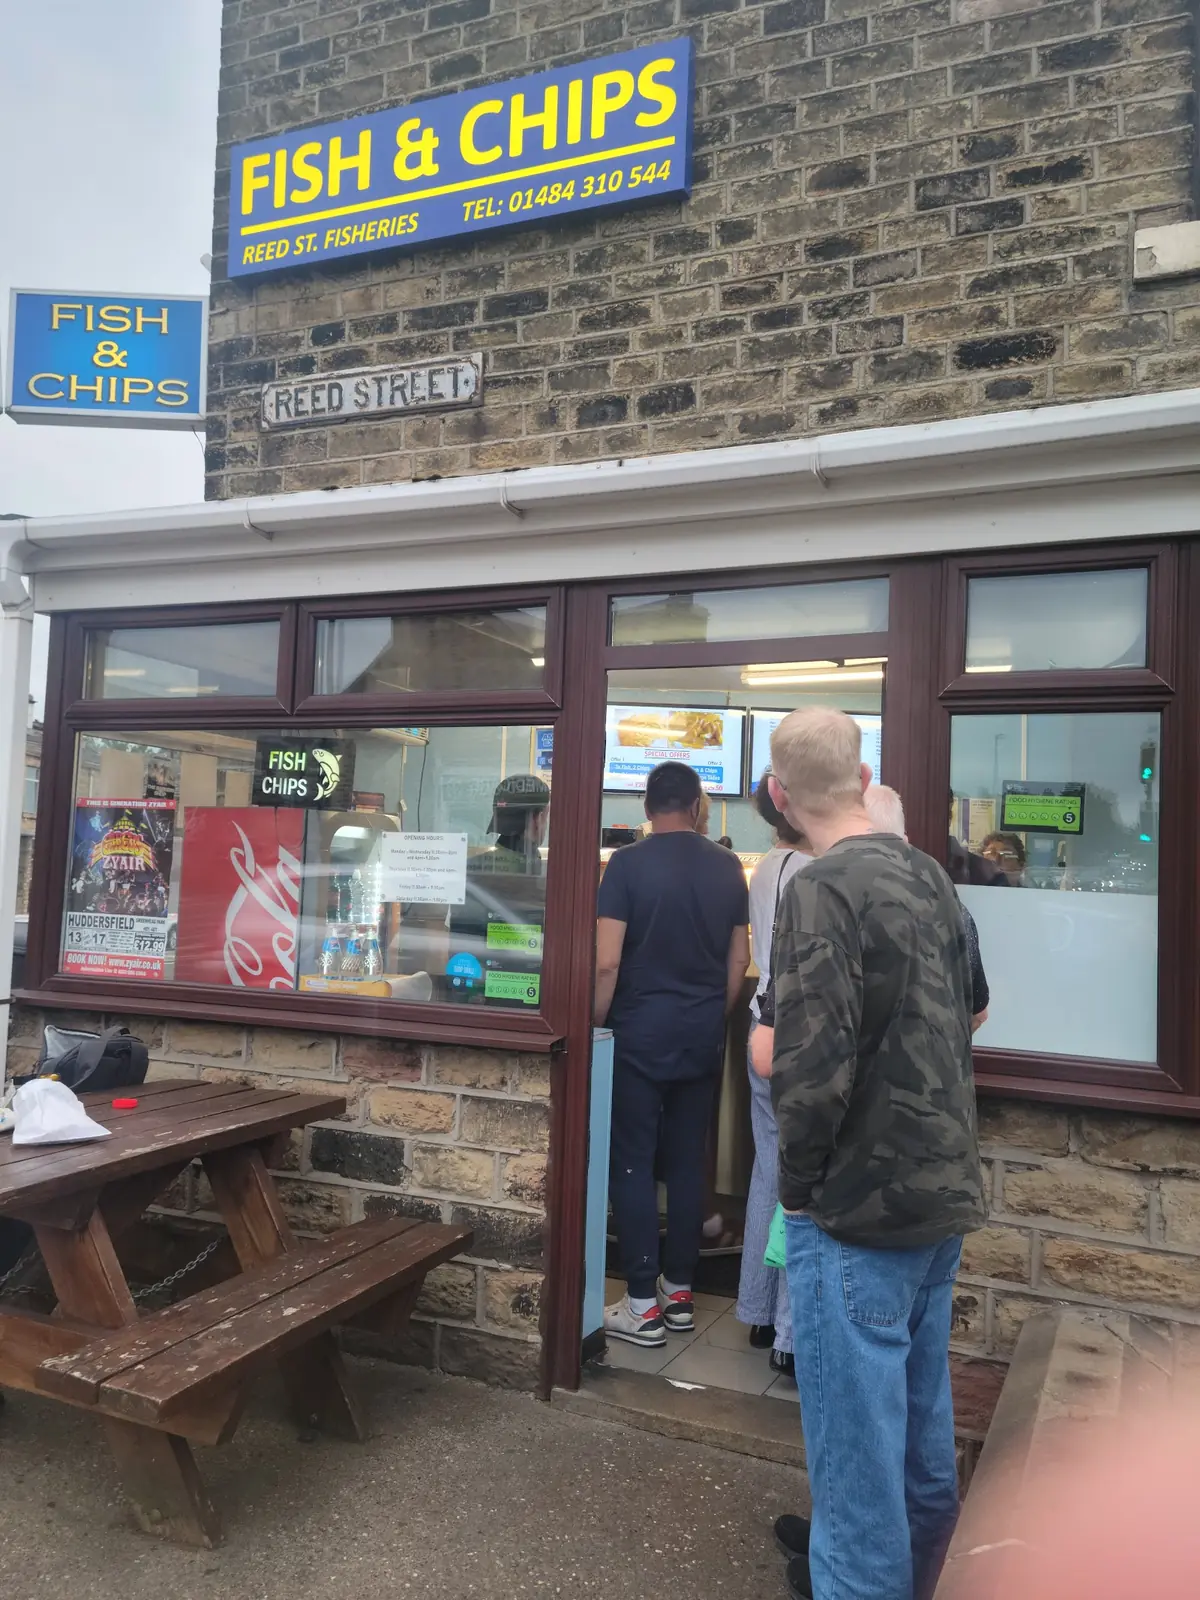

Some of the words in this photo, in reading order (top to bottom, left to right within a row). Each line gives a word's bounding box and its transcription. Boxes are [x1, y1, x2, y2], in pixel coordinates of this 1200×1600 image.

[240, 129, 372, 216] FISH
[392, 117, 440, 182] &
[459, 58, 677, 166] CHIPS
[463, 197, 503, 221] TEL:
[508, 179, 575, 213] 01484
[580, 169, 624, 198] 310
[627, 159, 671, 189] 544
[242, 239, 290, 265] REED
[293, 233, 319, 256] ST.
[323, 211, 419, 249] FISHERIES
[51, 303, 169, 334] FISH
[92, 341, 128, 368] &
[28, 372, 190, 406] CHIPS
[274, 381, 344, 420] REED
[353, 366, 465, 410] STREET
[268, 751, 307, 771] FISH
[644, 750, 667, 758] SPECIAL
[669, 751, 690, 759] OFFERS
[262, 776, 308, 797] CHIPS
[1066, 813, 1073, 823] 5
[102, 855, 146, 871] ZYAIR
[68, 914, 135, 930] HUDDERSFIELD
[68, 931, 82, 943] 13
[92, 933, 106, 945] 17
[134, 940, 165, 953] £12.99
[67, 952, 86, 964] BOOK
[87, 954, 107, 966] NOW!
[108, 957, 162, 970] www.zyair.co.uk
